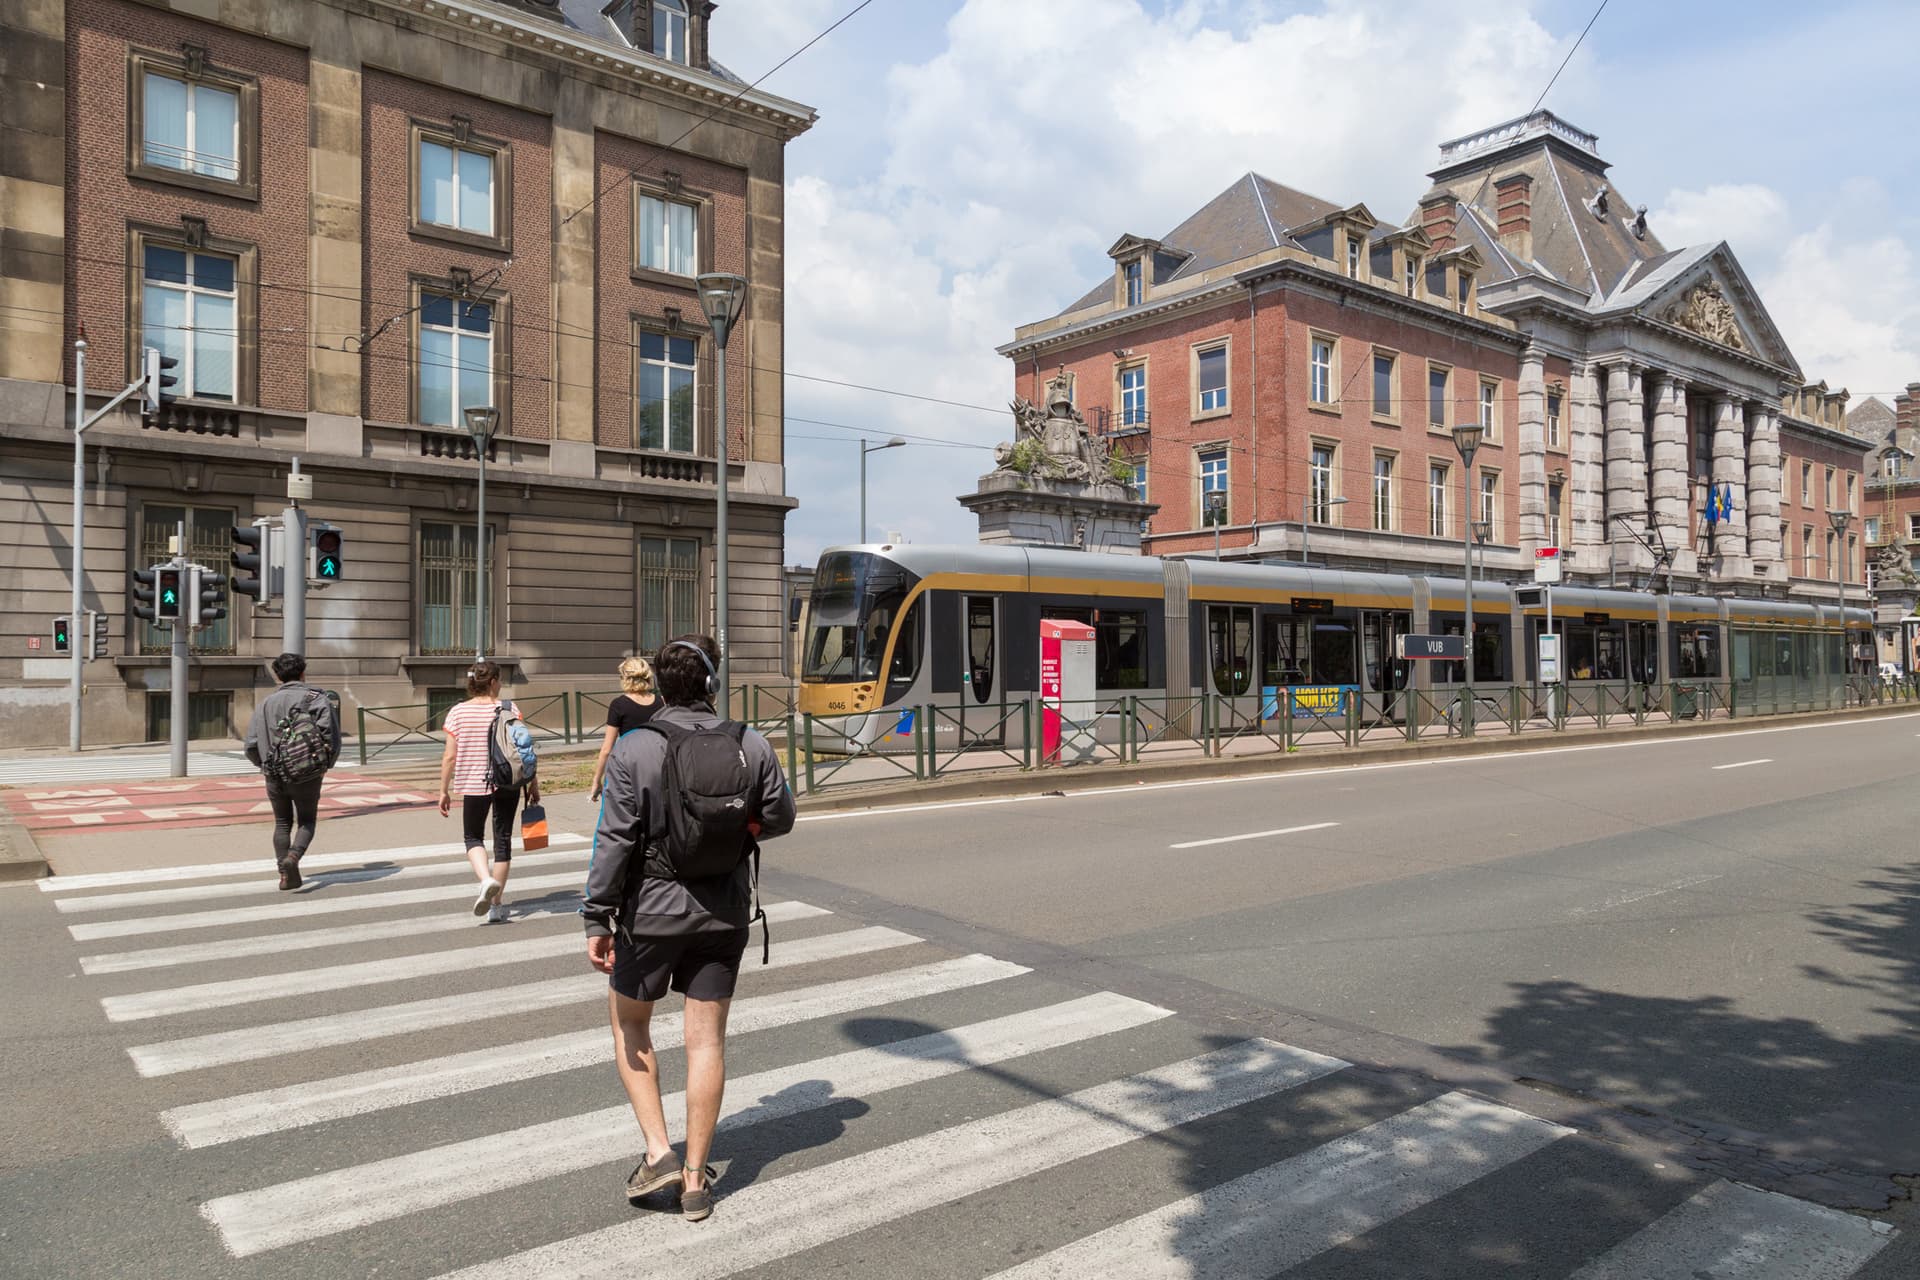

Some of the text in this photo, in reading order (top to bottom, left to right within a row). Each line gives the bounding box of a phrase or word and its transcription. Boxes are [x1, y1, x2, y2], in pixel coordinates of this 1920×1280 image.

[1427, 640, 1443, 653] VUB
[1296, 687, 1319, 708] MON
[828, 701, 846, 710] 4046
